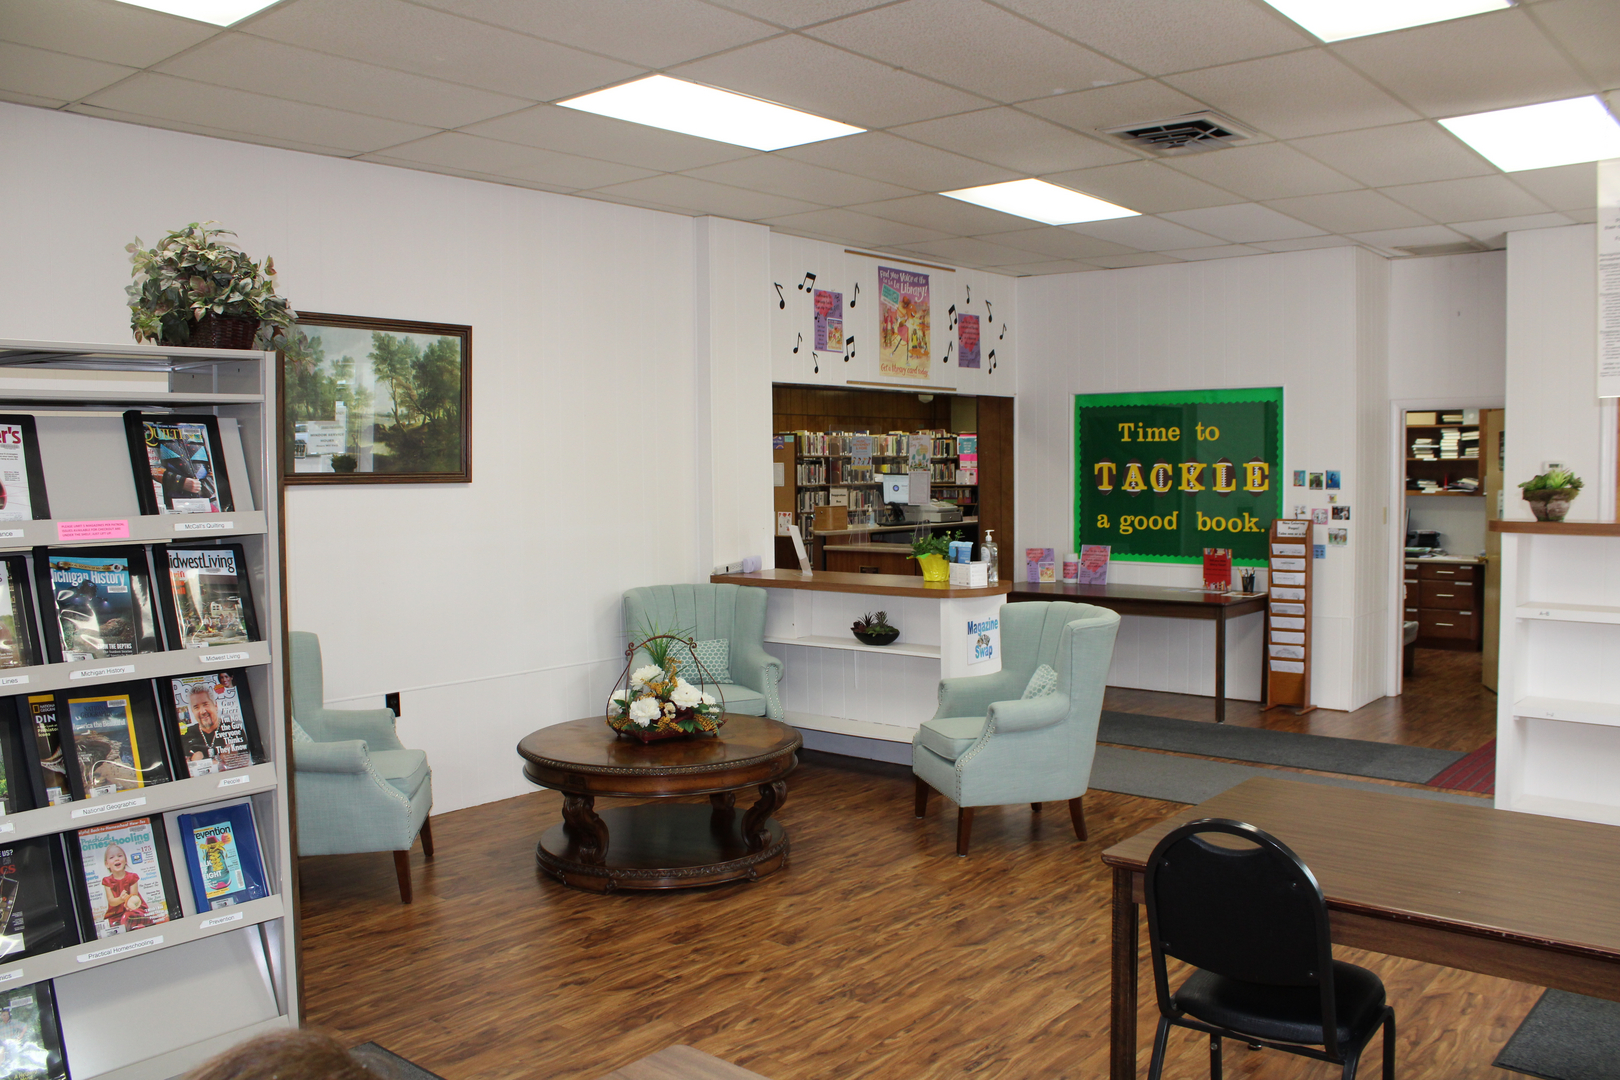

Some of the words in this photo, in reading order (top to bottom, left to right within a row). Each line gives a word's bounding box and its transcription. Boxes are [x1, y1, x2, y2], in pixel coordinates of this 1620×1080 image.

[901, 282, 928, 303] Library!
[0, 426, 22, 444] r's
[1118, 422, 1181, 442] Time
[1195, 421, 1220, 441] to
[1094, 462, 1270, 493] TACKLE
[1096, 513, 1110, 529] a
[1119, 511, 1179, 535] good
[1196, 511, 1266, 533] book.
[90, 570, 125, 587] History
[967, 617, 999, 636] Magazine
[975, 645, 993, 659] Swap
[81, 668, 106, 677] Michigan
[35, 713, 57, 724] DIN
[72, 721, 94, 730] America
[102, 718, 126, 727] Beautiful
[221, 723, 231, 731] the
[231, 722, 243, 731] Guy
[214, 730, 242, 739] Everyone
[224, 737, 244, 745] Thinks
[215, 746, 231, 754] They
[83, 806, 106, 815] National
[106, 800, 137, 810] Geographic
[82, 832, 150, 851] omeshooling
[208, 915, 235, 925] Prevention
[88, 948, 112, 959] Practical
[113, 938, 154, 953] Homeschooling
